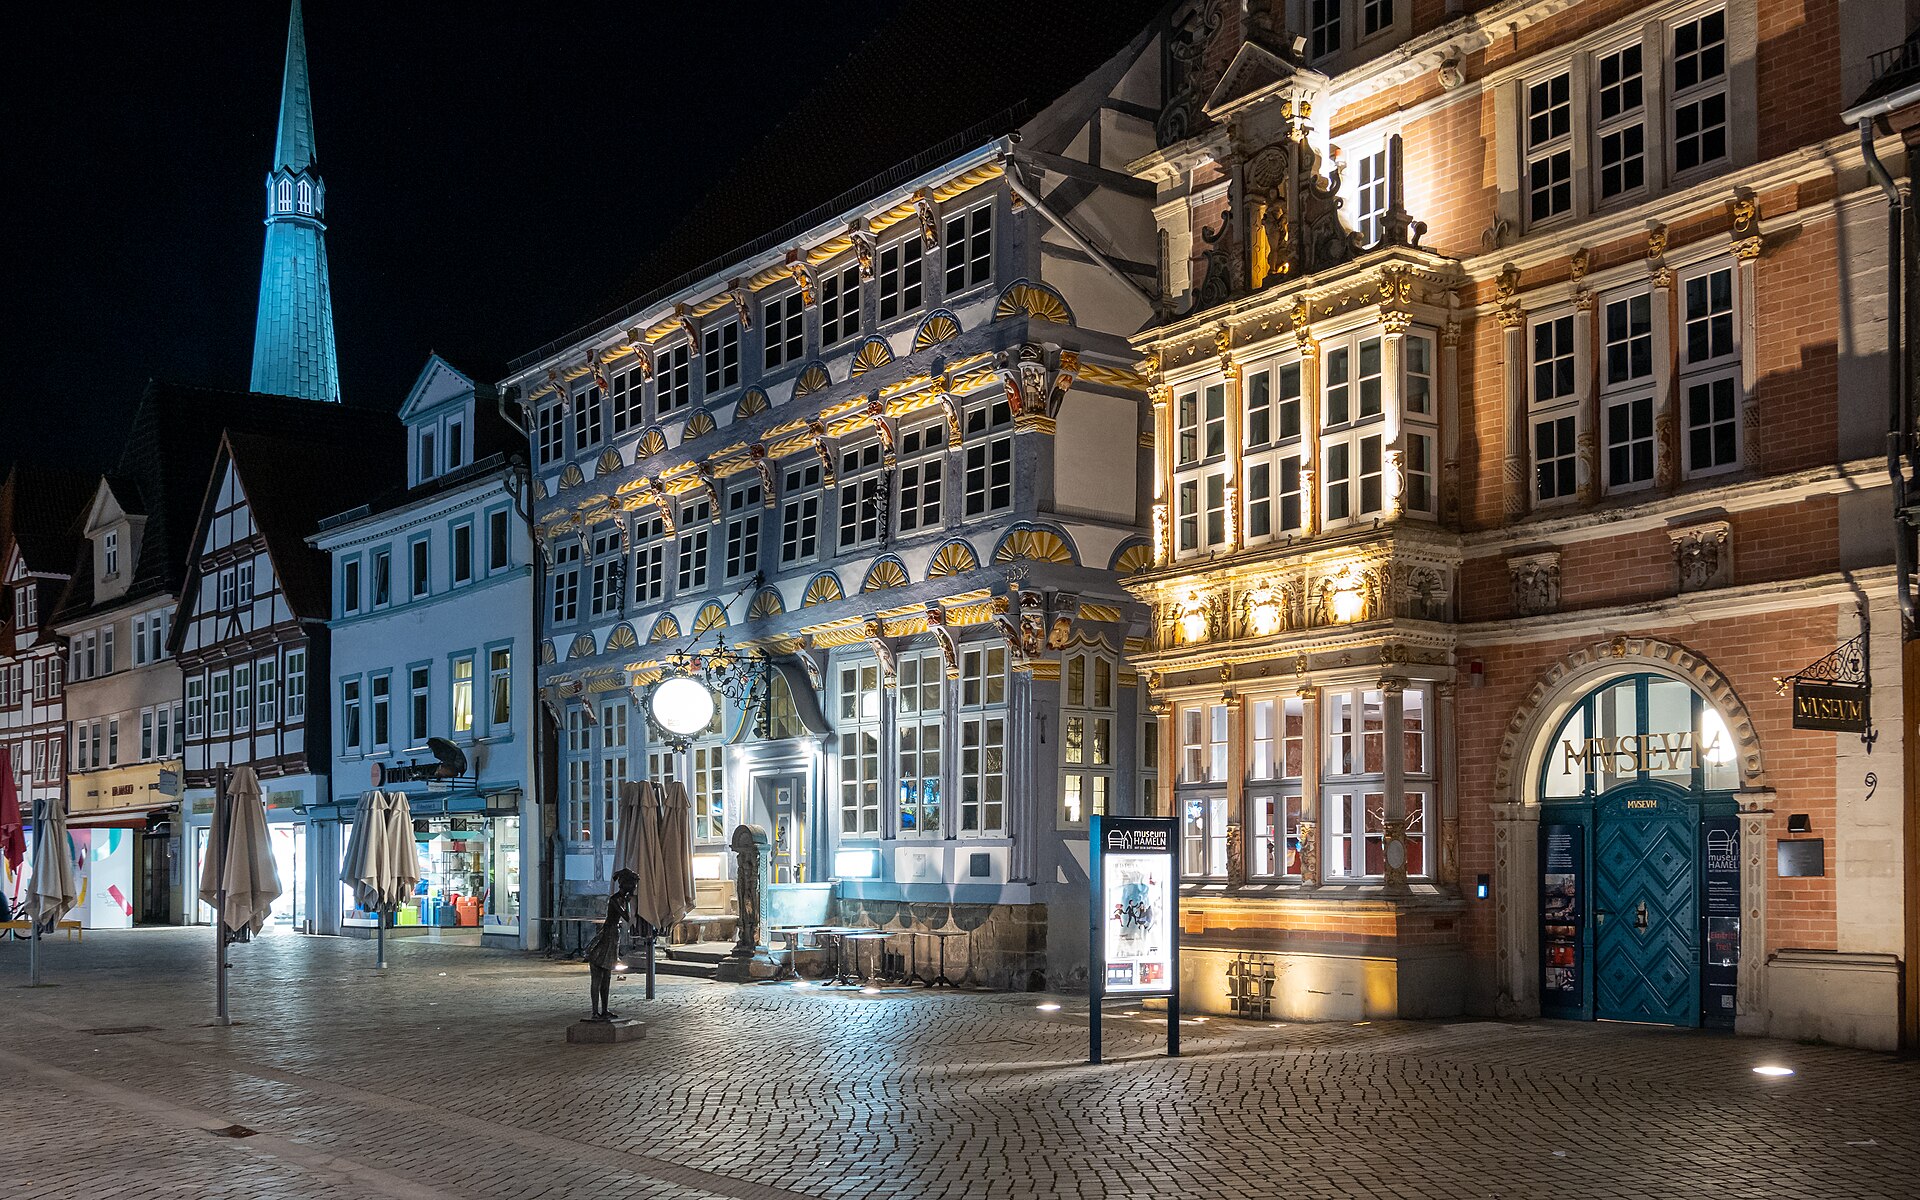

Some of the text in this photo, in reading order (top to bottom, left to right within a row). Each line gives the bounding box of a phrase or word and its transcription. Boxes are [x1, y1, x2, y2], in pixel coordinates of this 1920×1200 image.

[1796, 696, 1863, 721] MVSEVM
[1864, 772, 1878, 801] 9
[1627, 800, 1657, 809] MVSEVM
[1133, 830, 1167, 838] museum
[1133, 837, 1167, 846] HAMELN
